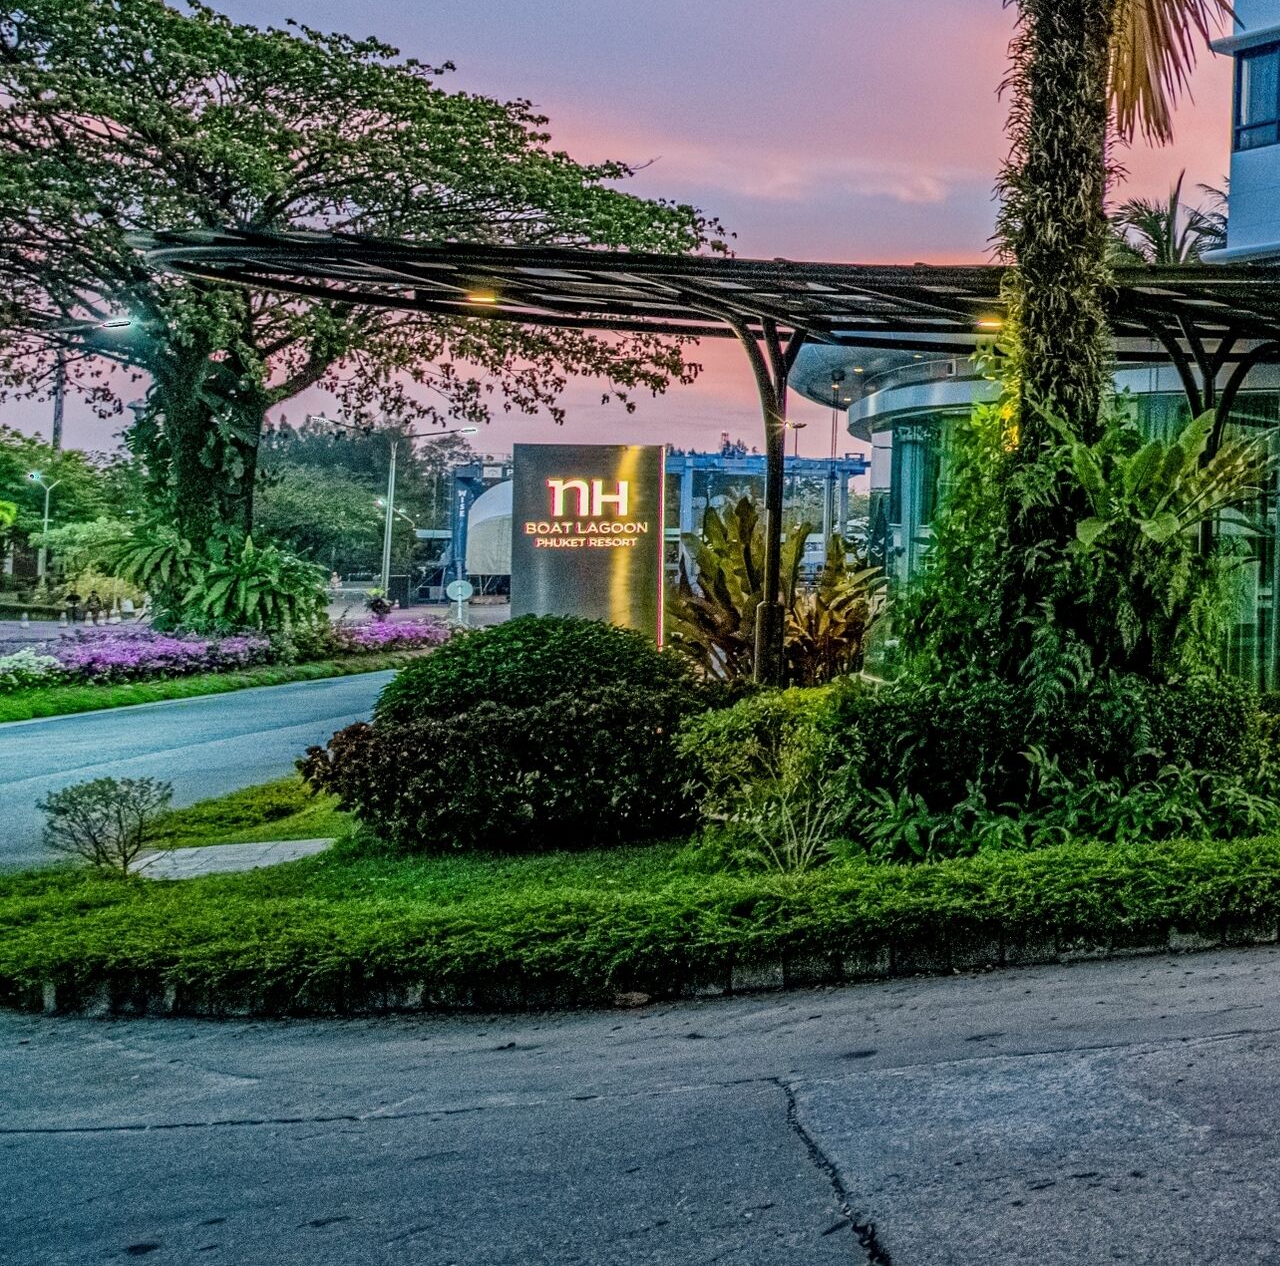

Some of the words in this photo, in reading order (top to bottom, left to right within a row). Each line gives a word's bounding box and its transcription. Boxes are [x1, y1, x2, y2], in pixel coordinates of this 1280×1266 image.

[547, 478, 629, 517] nH
[525, 522, 573, 535] BOAT
[576, 521, 649, 534] LAGOON
[536, 537, 587, 548] PHUKET
[588, 537, 638, 548] RESORT
